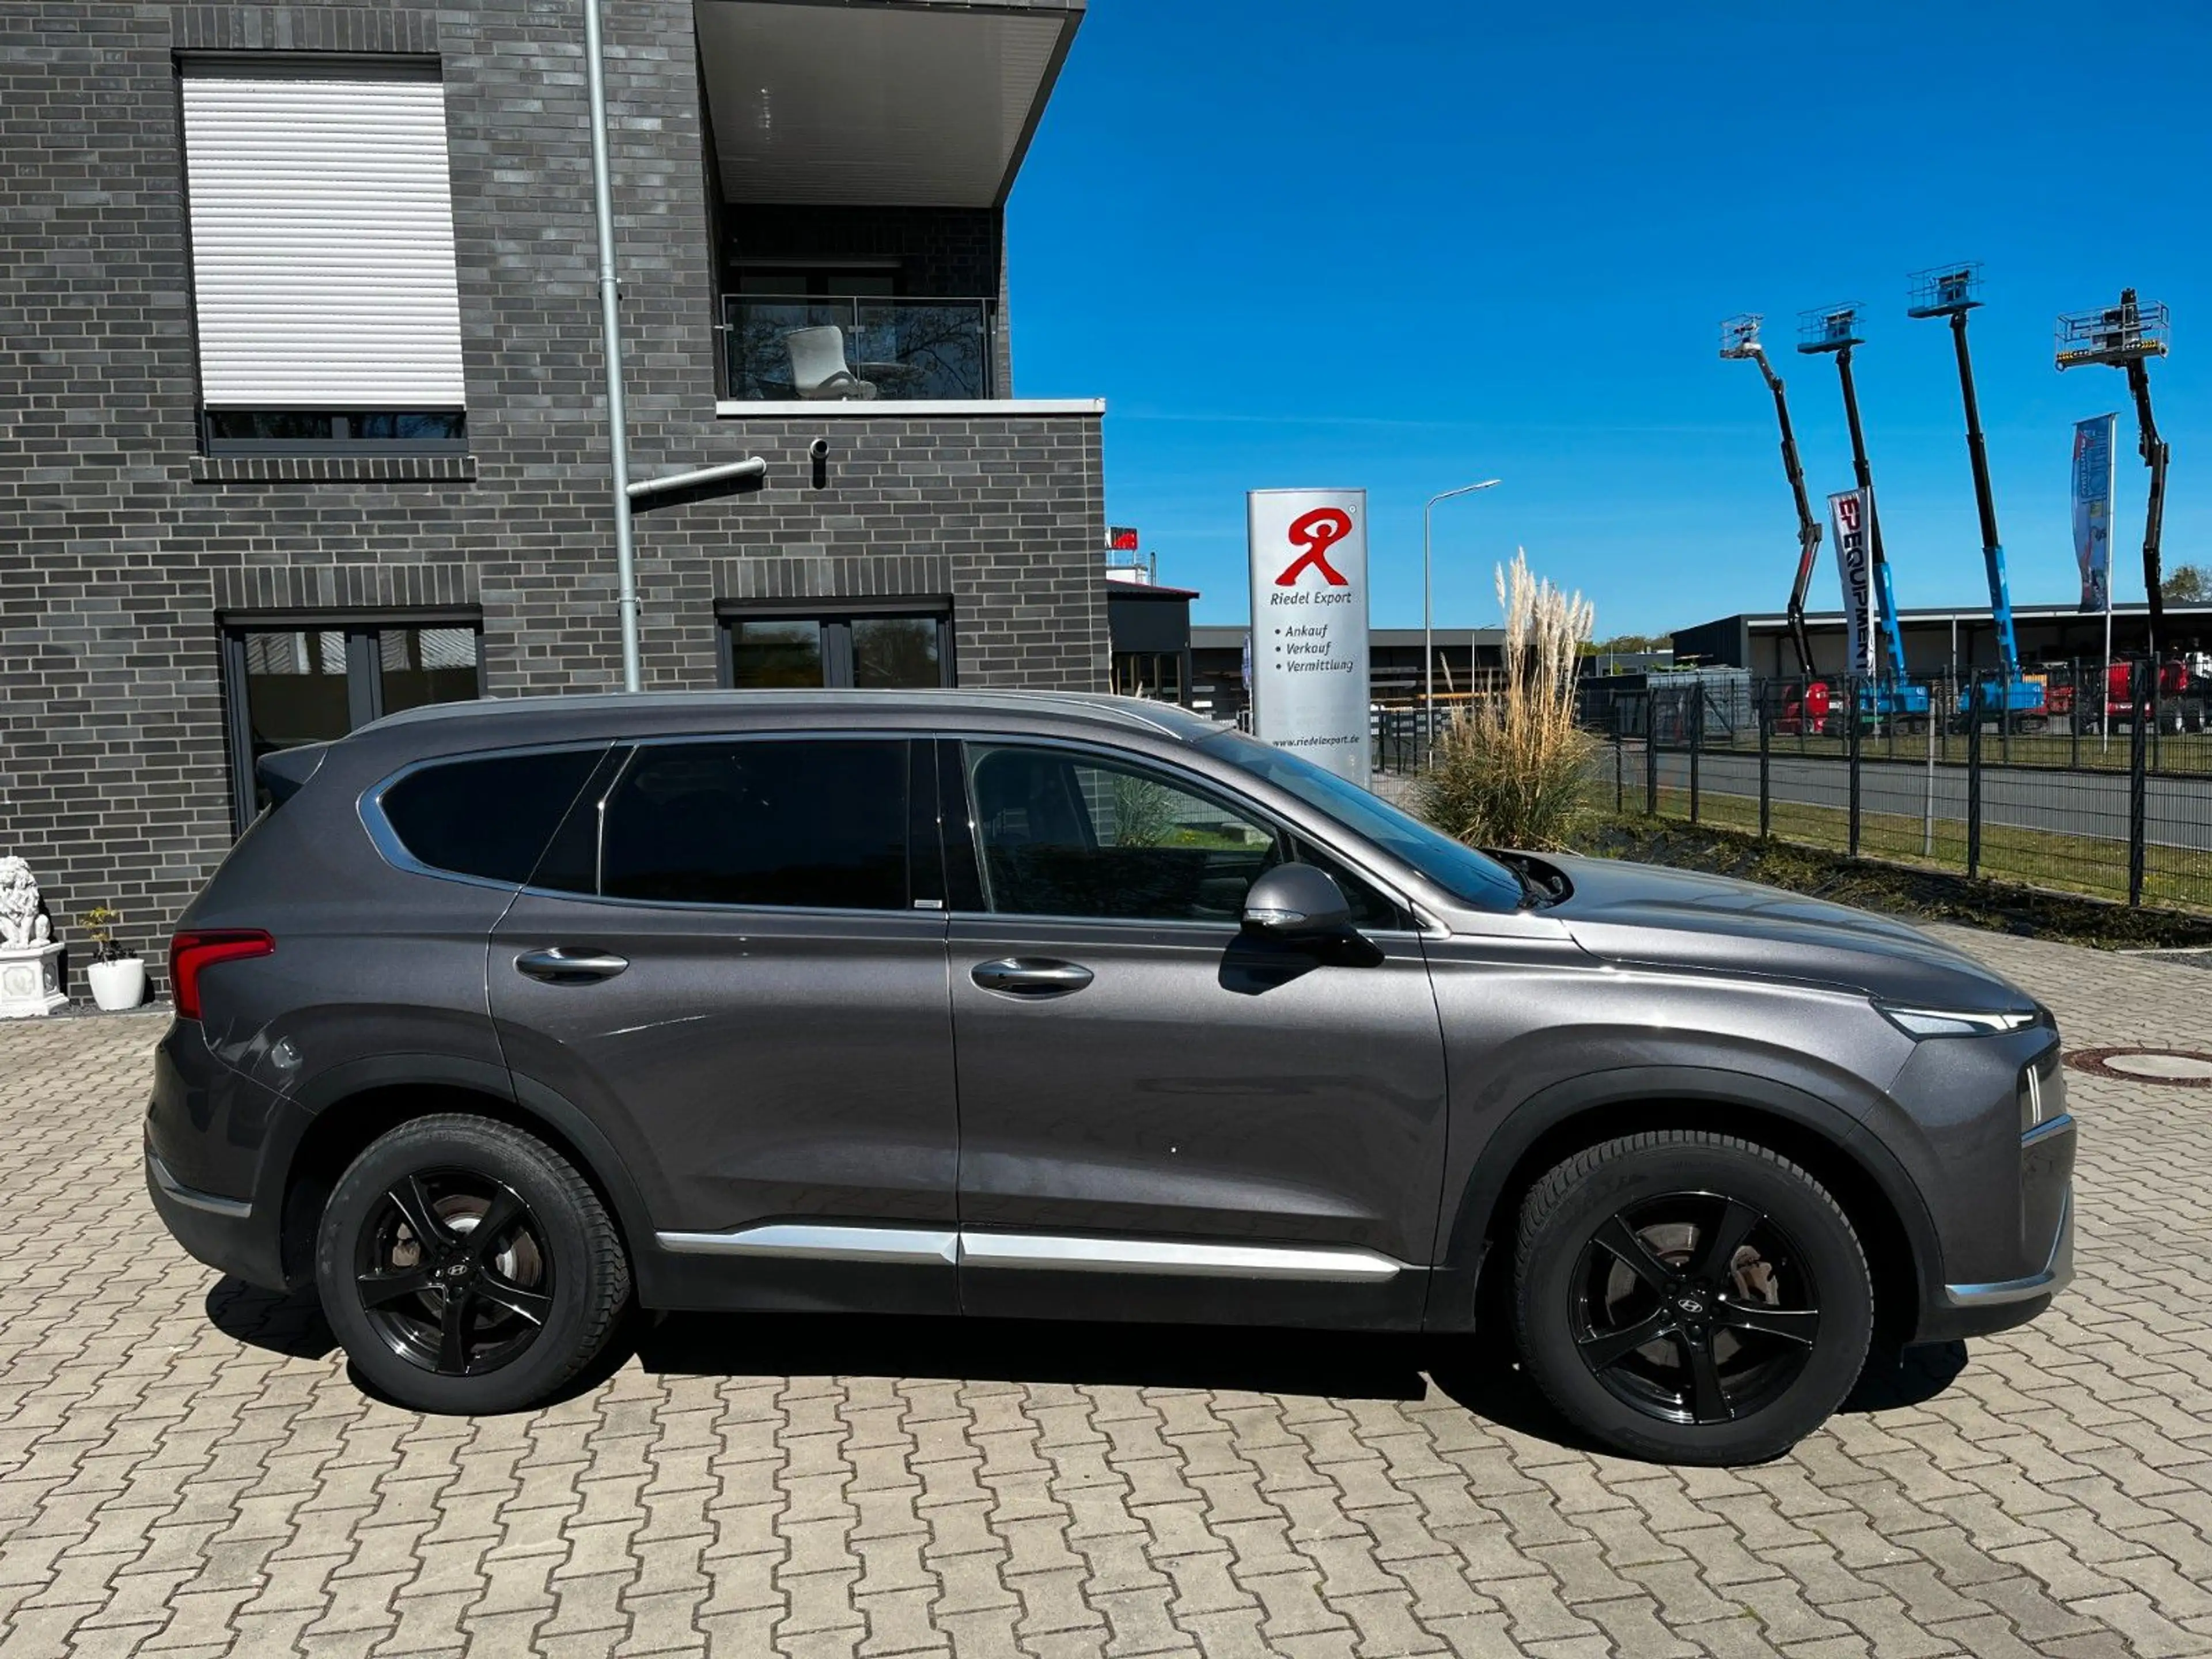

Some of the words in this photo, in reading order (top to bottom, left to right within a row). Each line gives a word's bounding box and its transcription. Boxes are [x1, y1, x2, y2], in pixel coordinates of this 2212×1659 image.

[1839, 498, 1861, 531] EP
[1270, 592, 1309, 605] Riedel
[1314, 592, 1352, 605] Export
[1286, 624, 1328, 638] Ankauf
[1287, 641, 1331, 656] Verkauf
[1287, 659, 1353, 672] Vermittlung
[1272, 734, 1360, 747] www.riedelexport.de
